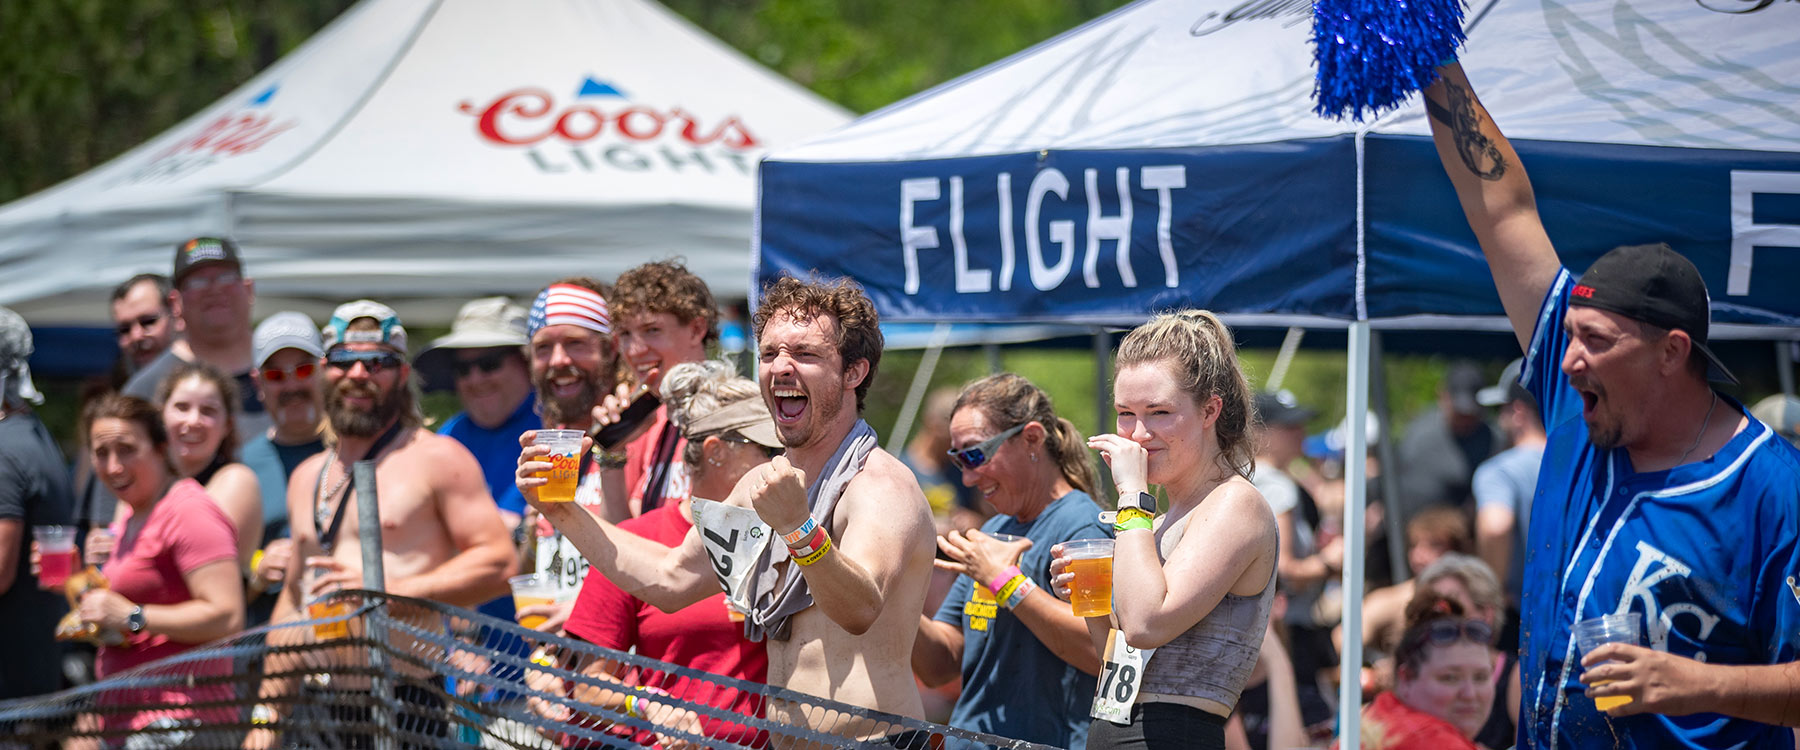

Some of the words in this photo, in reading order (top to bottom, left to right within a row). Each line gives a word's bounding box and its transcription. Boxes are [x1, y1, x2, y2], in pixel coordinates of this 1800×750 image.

[455, 86, 763, 147] Coors
[525, 143, 752, 174] LIGHT
[900, 164, 1187, 296] FLIGHT
[784, 530, 801, 544] VIP
[800, 518, 814, 534] VIP
[1101, 661, 1136, 703] 78
